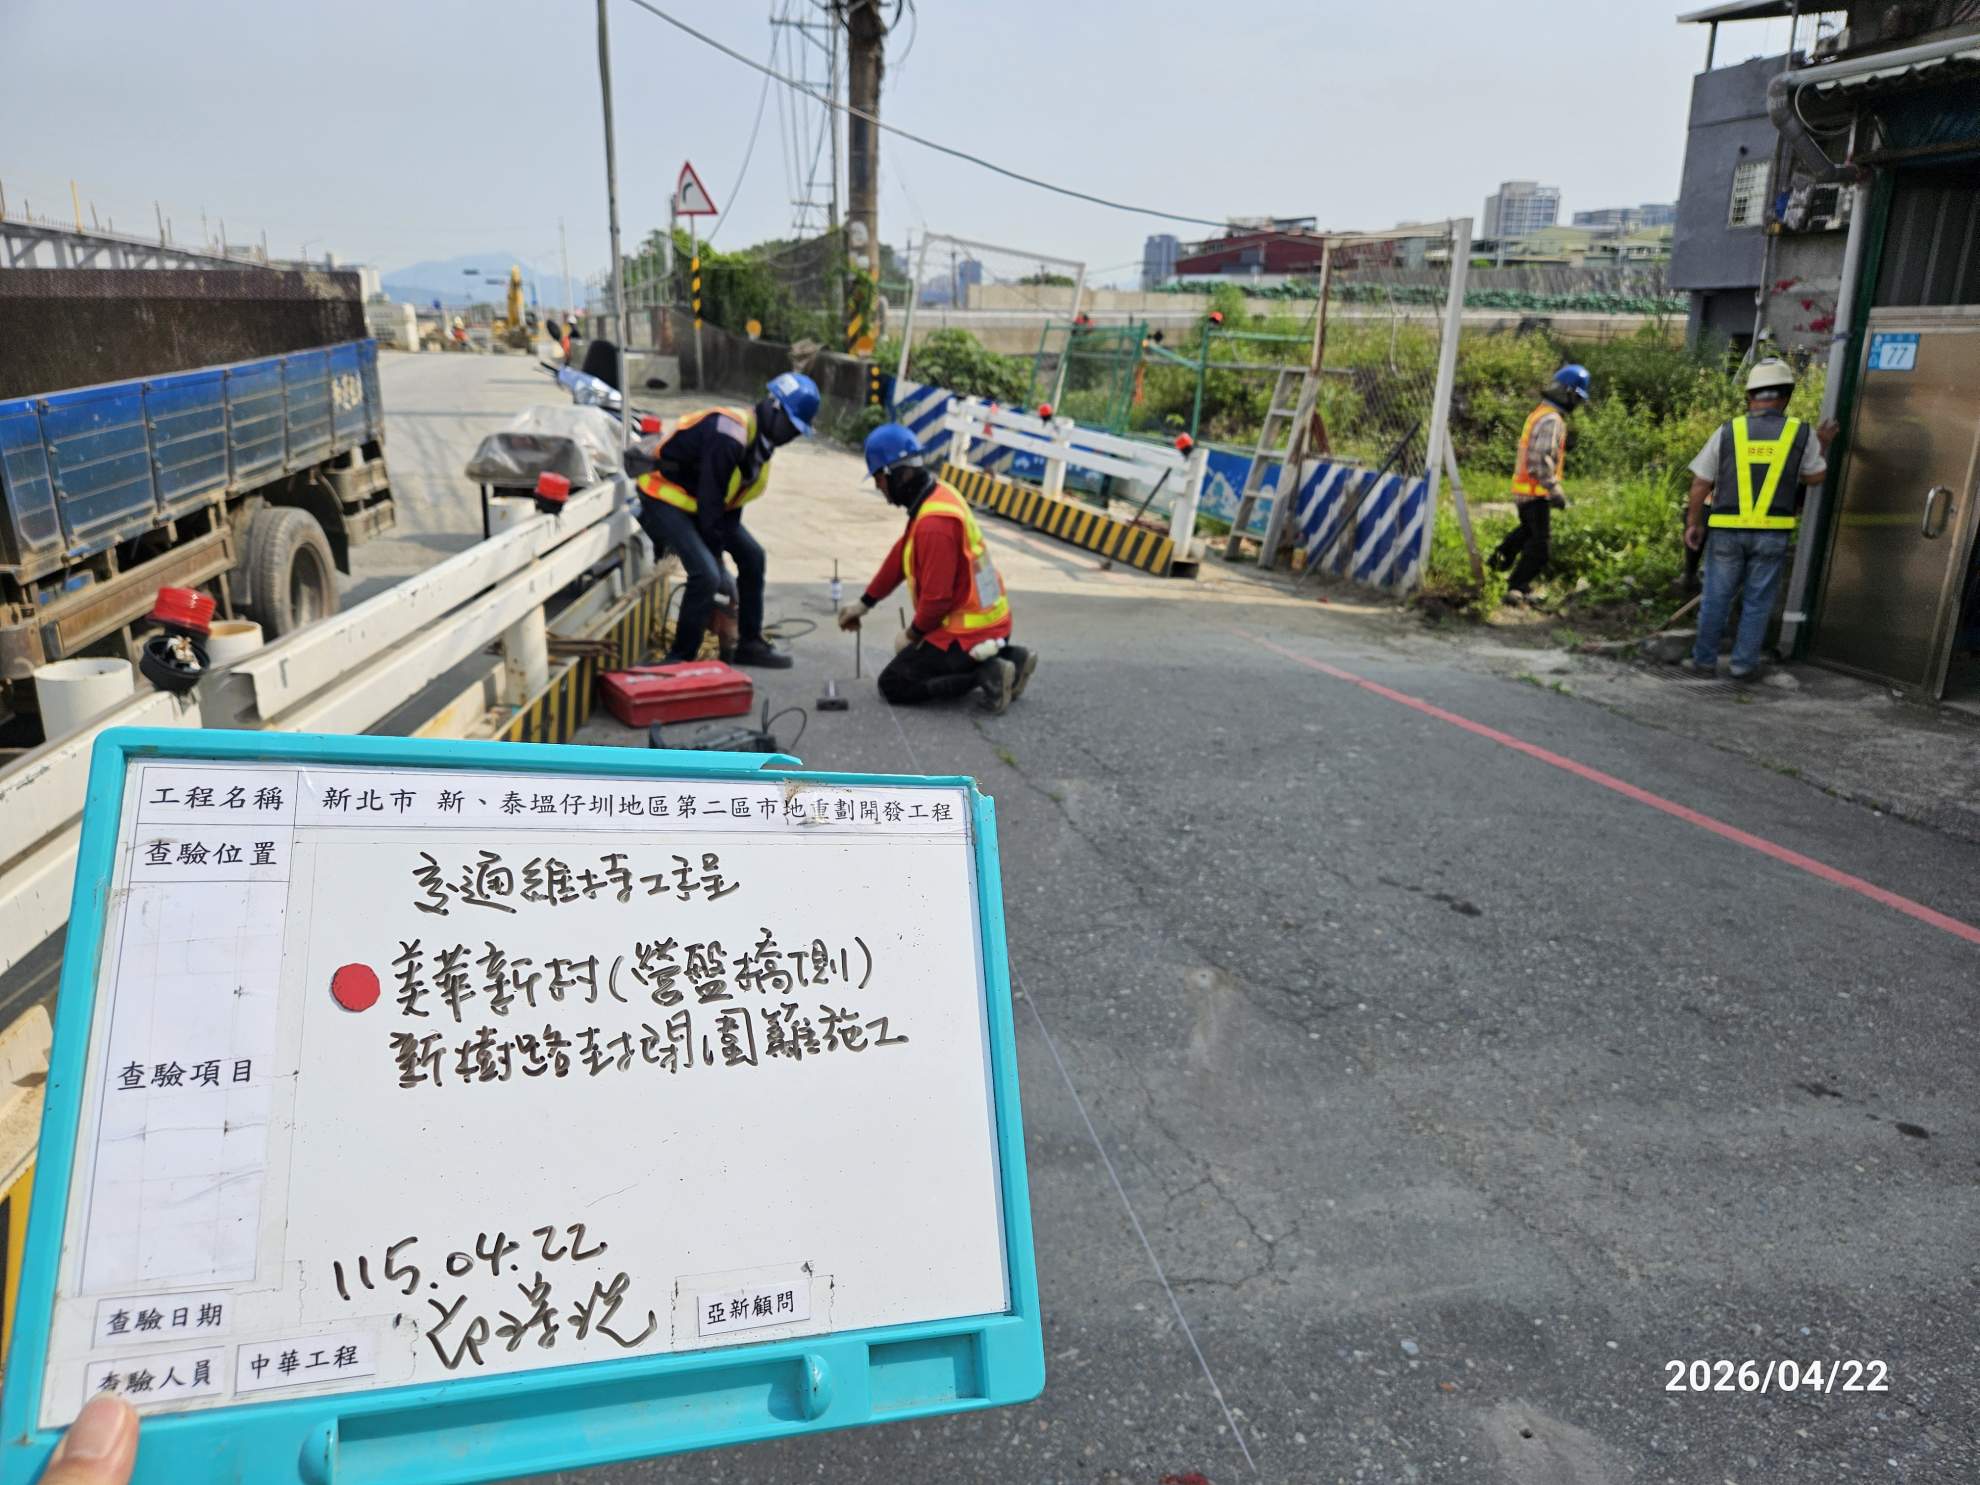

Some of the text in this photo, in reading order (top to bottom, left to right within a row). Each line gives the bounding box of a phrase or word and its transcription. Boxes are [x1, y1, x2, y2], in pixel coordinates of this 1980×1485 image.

[148, 785, 286, 812] 工程名稱
[322, 786, 417, 814] 新北市
[144, 841, 278, 867] 查驗位置
[116, 1059, 253, 1091] 查驗項目
[333, 1222, 608, 1301] 115.04.22
[107, 1303, 223, 1336] 查驗日期
[707, 1289, 795, 1325] 亞新顧問
[250, 1344, 358, 1380] 中華工程
